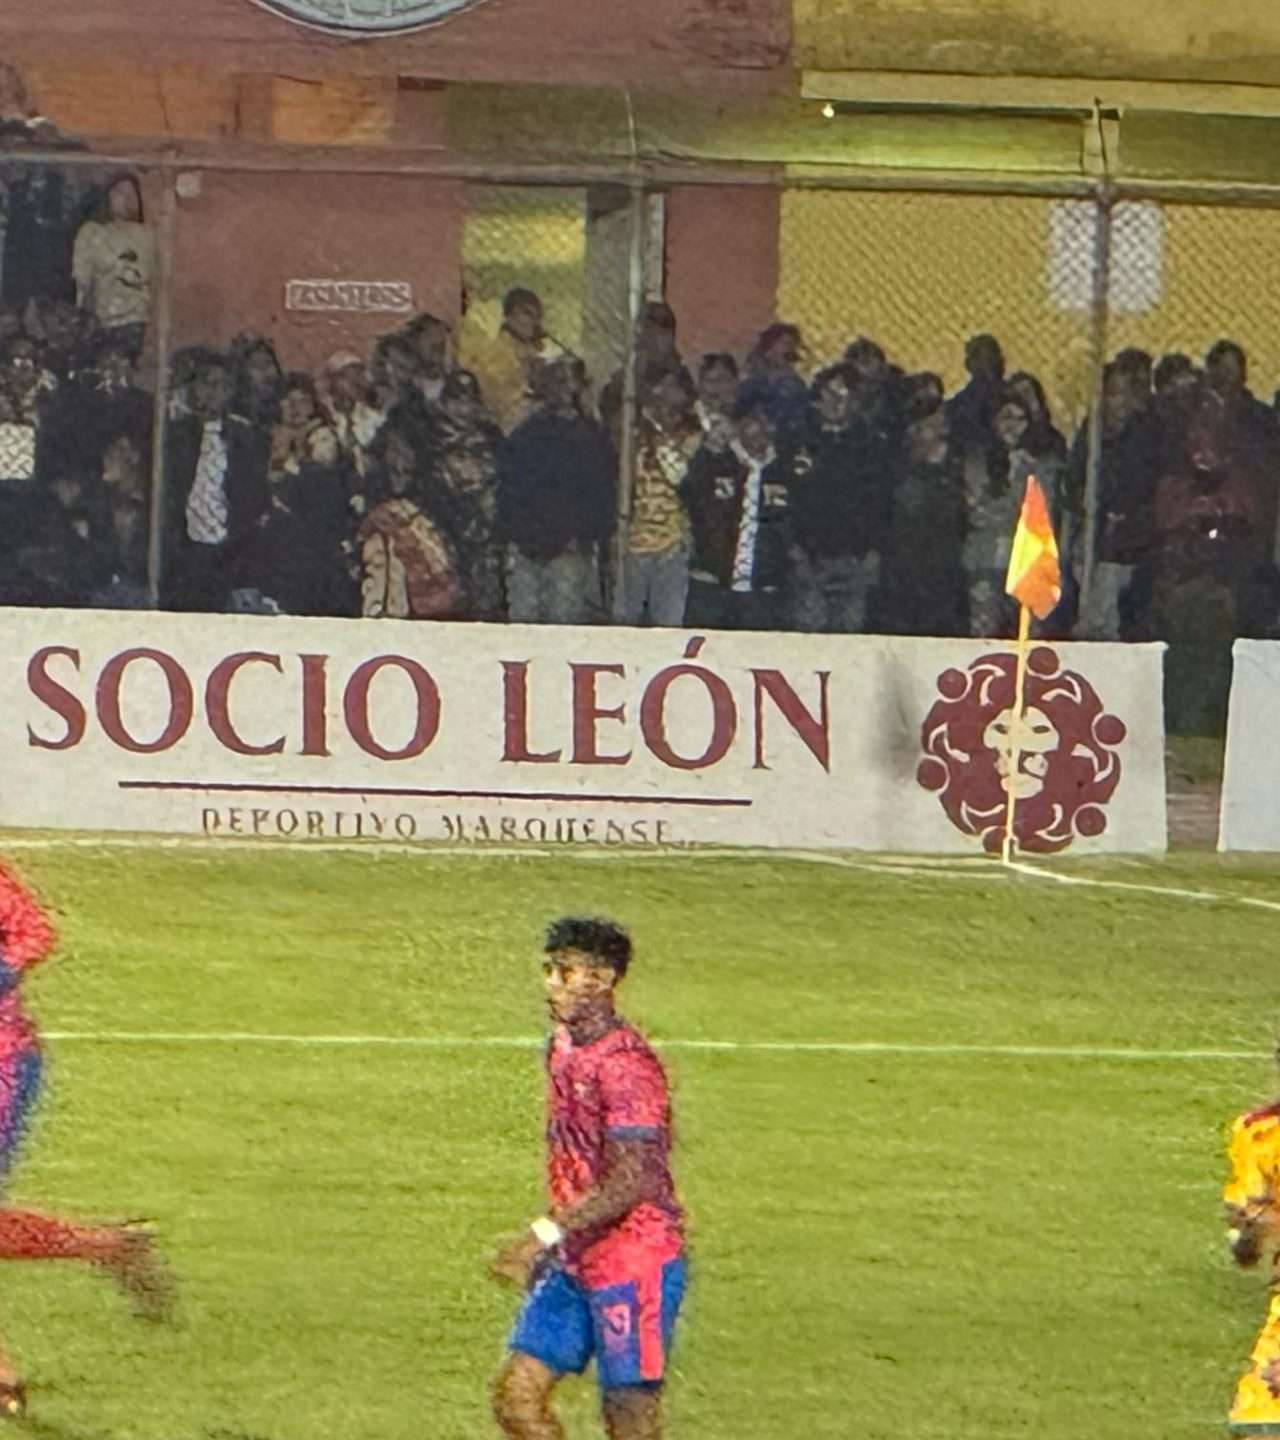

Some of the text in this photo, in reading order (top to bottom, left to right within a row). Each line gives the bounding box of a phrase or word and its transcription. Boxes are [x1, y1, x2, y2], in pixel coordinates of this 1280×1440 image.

[27, 636, 831, 774] SOCIO LEÓN
[201, 807, 417, 839] DEPORTIVO
